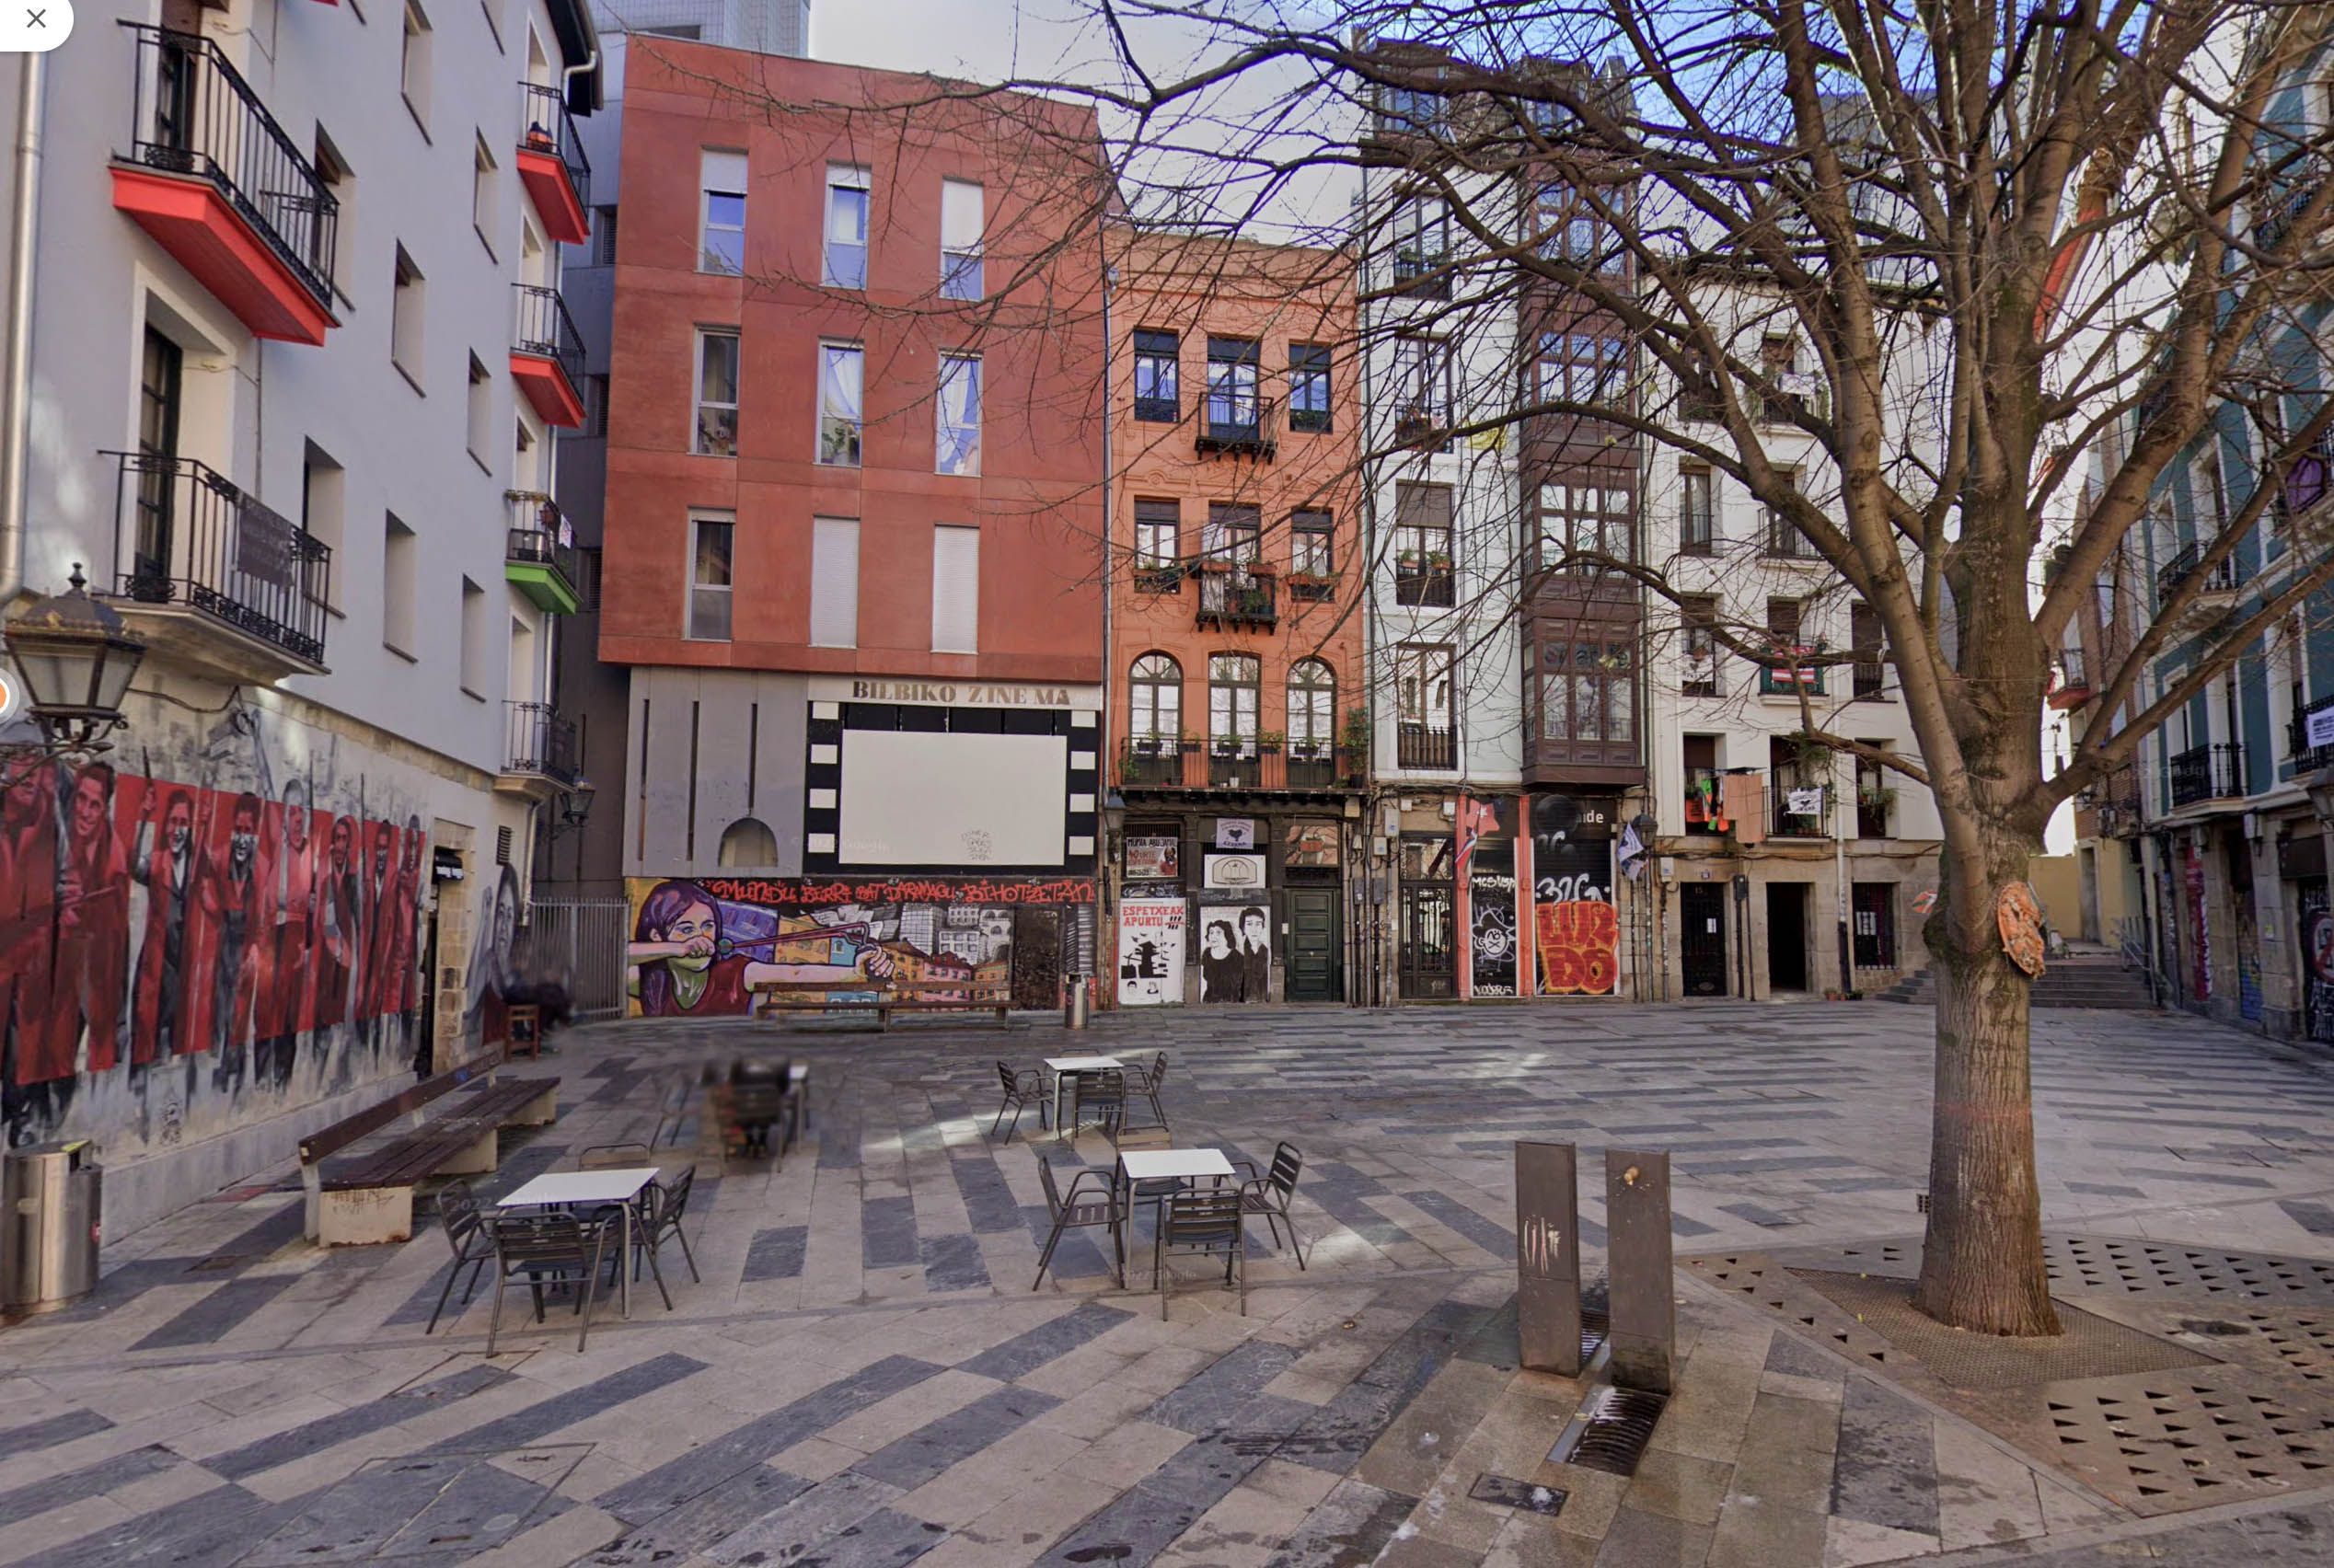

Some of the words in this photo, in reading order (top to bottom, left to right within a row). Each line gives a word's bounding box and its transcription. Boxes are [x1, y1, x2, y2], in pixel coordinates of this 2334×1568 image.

[853, 681, 956, 702] BILBIKO
[967, 685, 1070, 705] ZINEMA
[712, 881, 798, 904] MUNDU
[800, 882, 852, 904] BERRI
[1122, 905, 1184, 917] ESPETXEAK
[1124, 917, 1163, 927] APURTU
